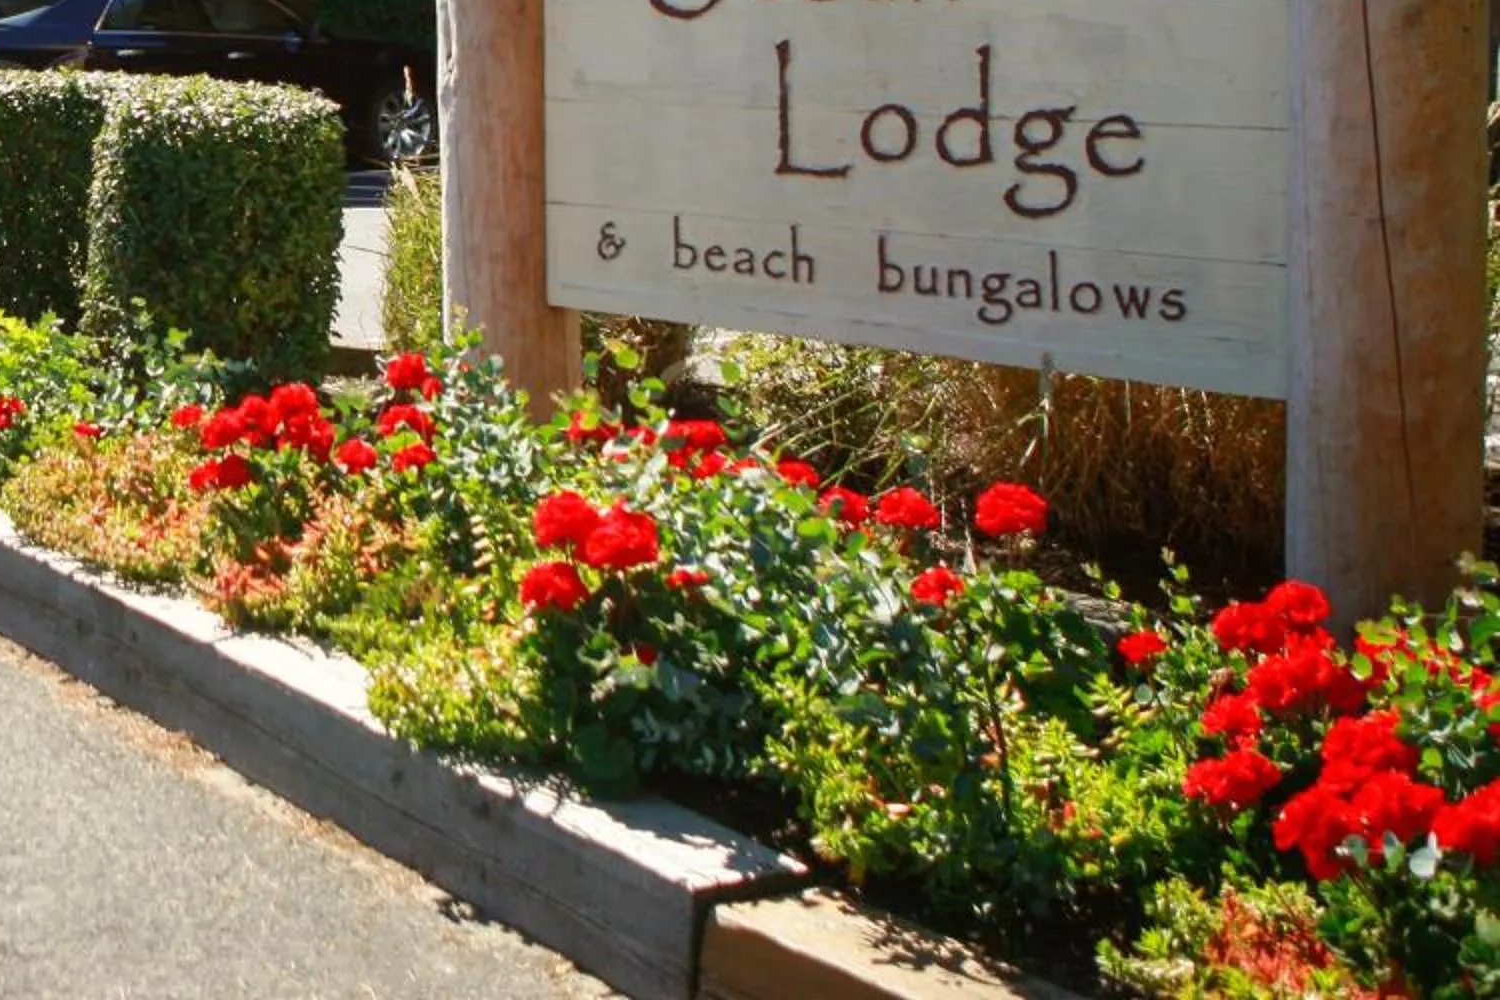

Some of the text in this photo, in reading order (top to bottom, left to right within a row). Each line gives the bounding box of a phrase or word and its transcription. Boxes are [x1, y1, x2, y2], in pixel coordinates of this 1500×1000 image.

[774, 39, 1145, 220] Lodge
[596, 215, 1187, 325] & beach bungalows
